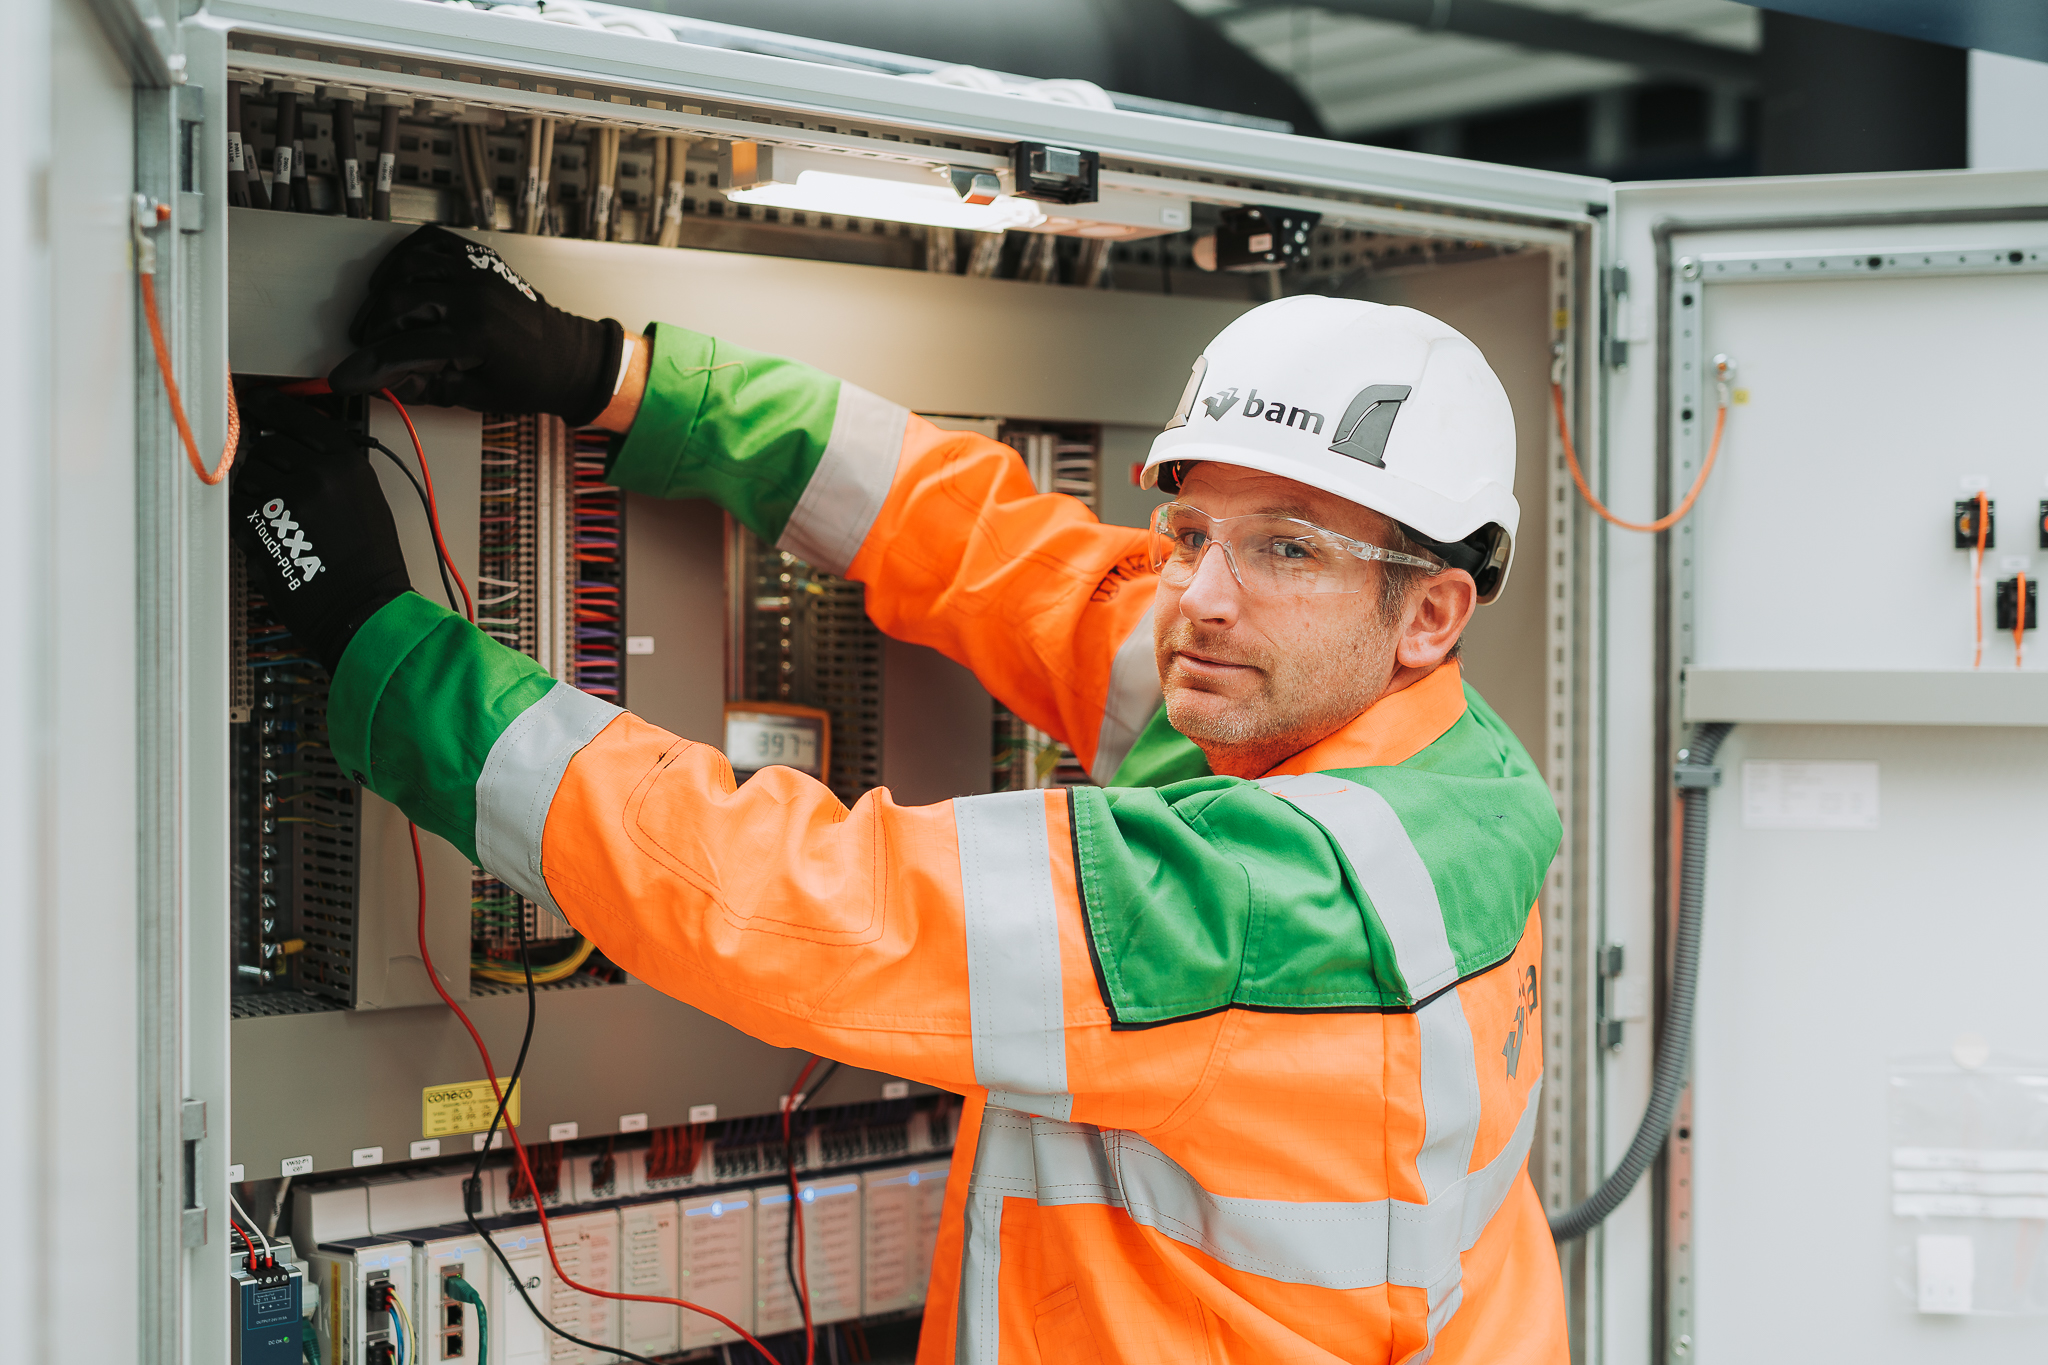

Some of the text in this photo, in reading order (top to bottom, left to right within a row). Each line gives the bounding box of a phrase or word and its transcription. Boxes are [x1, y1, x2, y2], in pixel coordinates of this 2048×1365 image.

[1242, 388, 1325, 435] bam
[246, 509, 302, 592] X-Touch-PU-B
[427, 1090, 474, 1104] coneco
